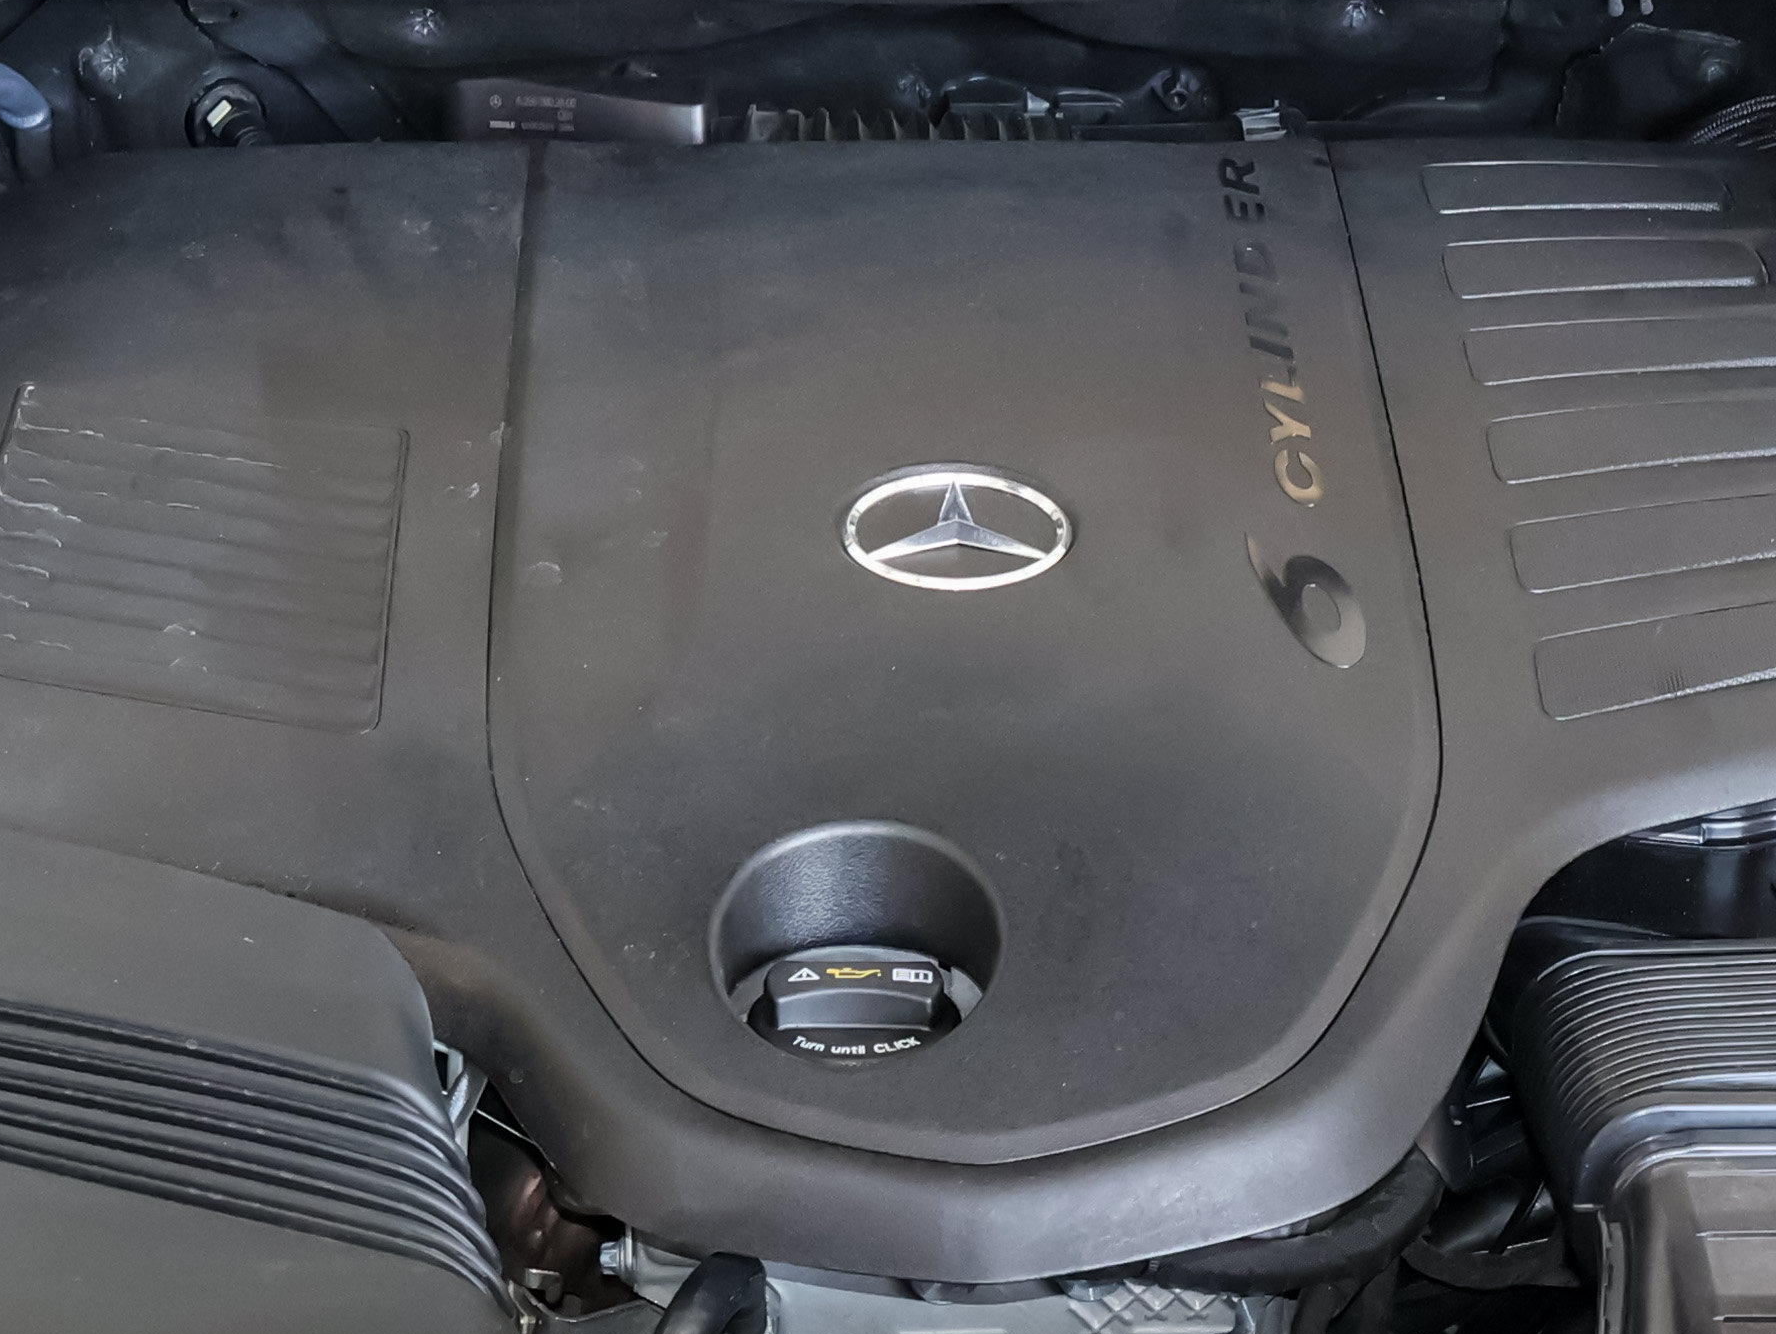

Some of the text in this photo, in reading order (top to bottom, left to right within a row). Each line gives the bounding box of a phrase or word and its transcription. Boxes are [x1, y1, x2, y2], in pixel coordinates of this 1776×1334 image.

[1219, 156, 1367, 669] 6 CYLINDER
[793, 1035, 921, 1055] Turn until CLICK
